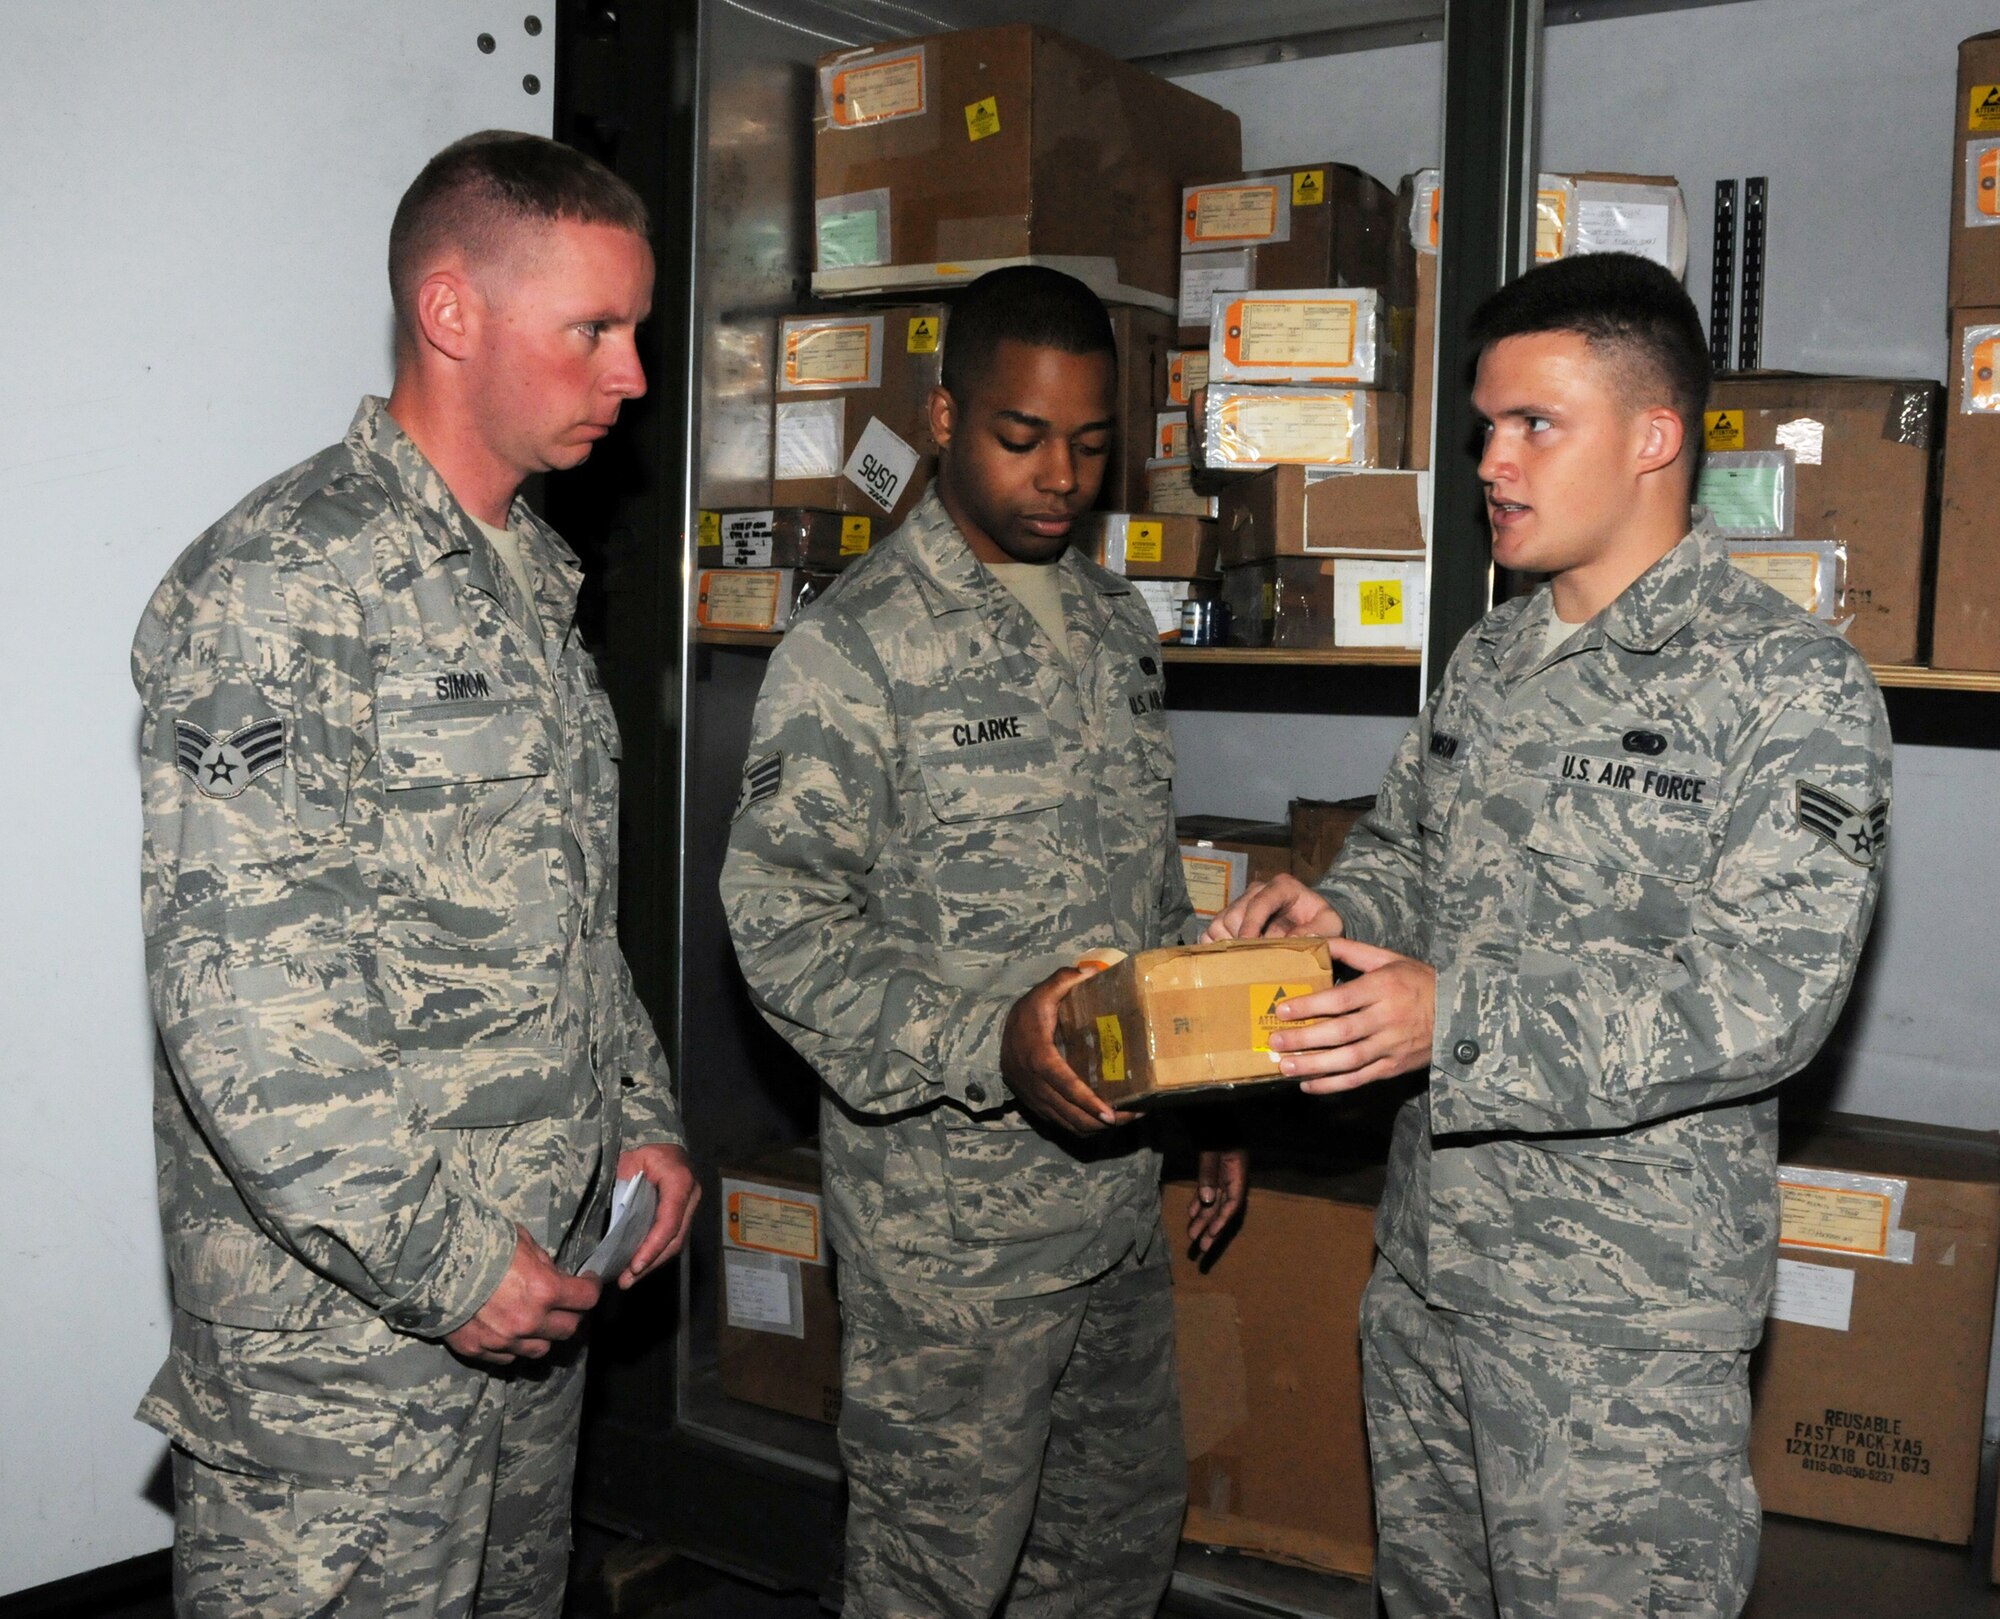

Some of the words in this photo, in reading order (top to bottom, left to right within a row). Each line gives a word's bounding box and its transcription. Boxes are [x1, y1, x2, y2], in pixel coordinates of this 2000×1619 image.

[858, 453, 899, 499] USA5
[435, 672, 490, 701] SIMON
[952, 716, 1023, 748] CLARKE
[1561, 754, 1591, 783] U.S.
[1597, 762, 1637, 790] AIR
[1642, 770, 1707, 804] FORCE
[1794, 1422, 1835, 1443] FAST
[1824, 1409, 1902, 1435] REUSABLE
